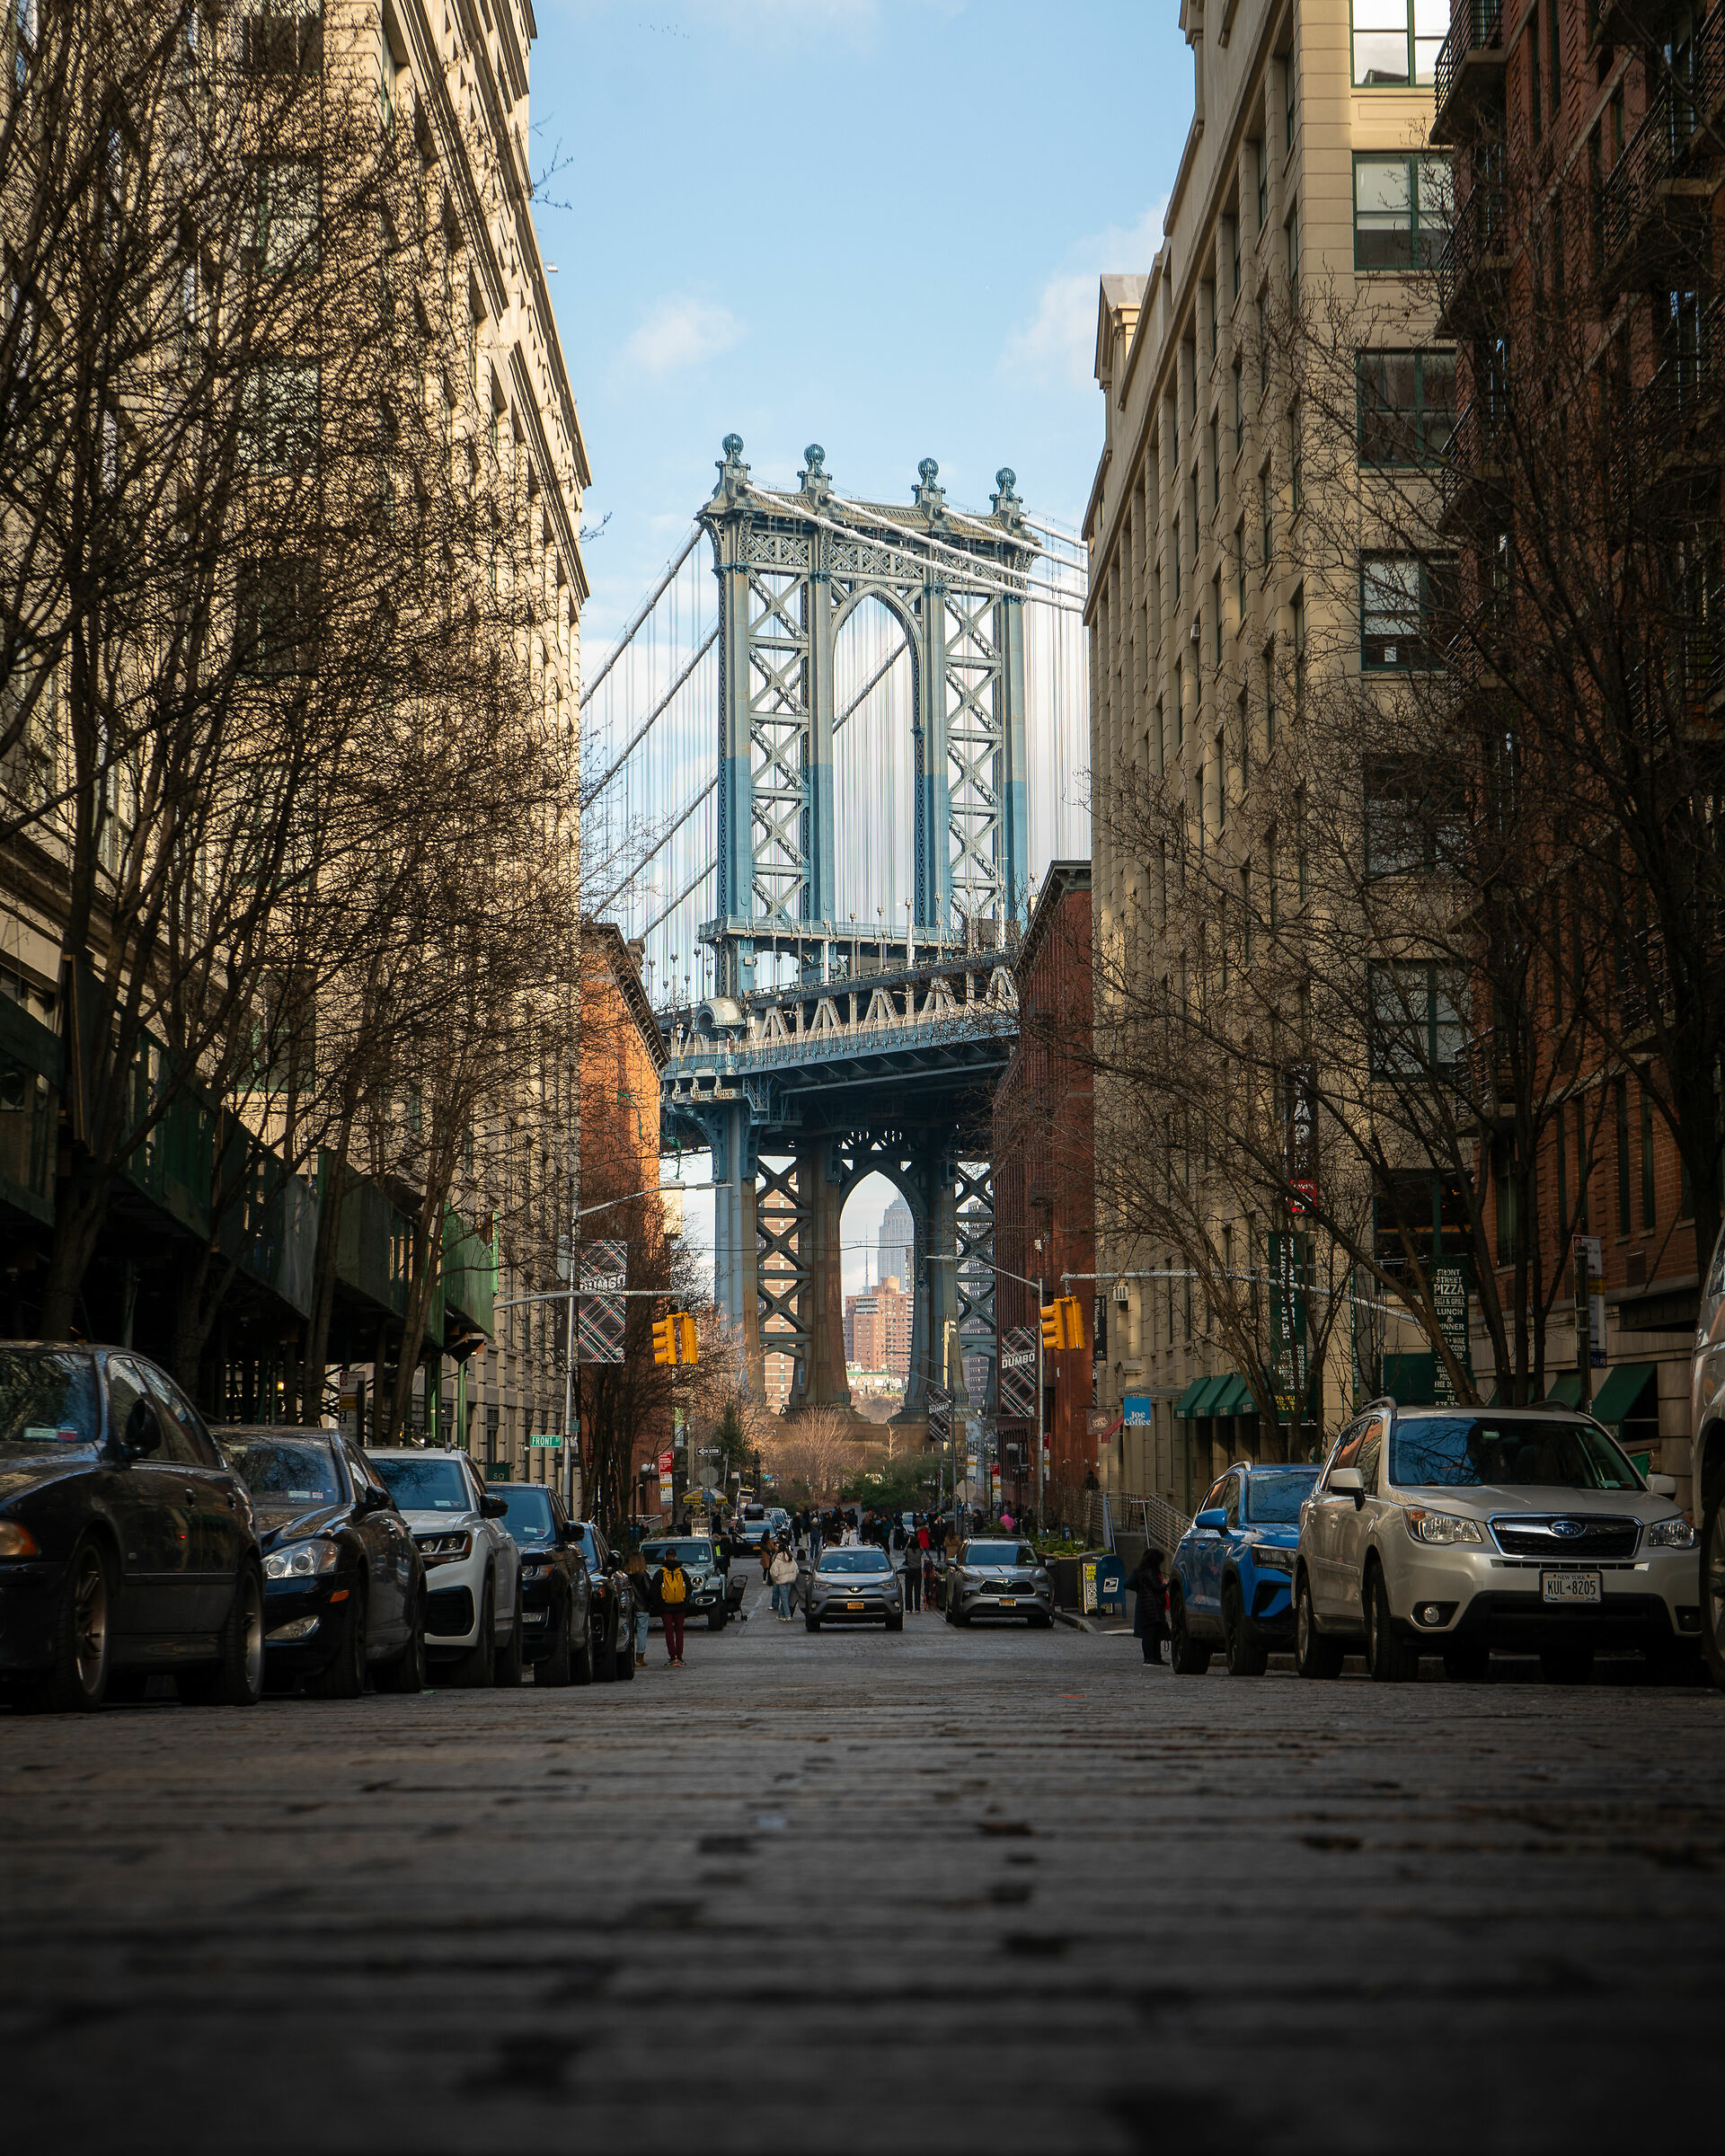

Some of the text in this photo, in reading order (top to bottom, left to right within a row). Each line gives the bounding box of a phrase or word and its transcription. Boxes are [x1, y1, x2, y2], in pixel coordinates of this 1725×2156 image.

[1433, 1284, 1464, 1294] PIZZA
[1002, 1352, 1035, 1369] DUMBO
[929, 1404, 949, 1414] DUMBO
[1129, 1411, 1146, 1420] Joe
[1124, 1417, 1151, 1426] Coffee
[532, 1437, 553, 1445] FRONT
[493, 1473, 505, 1481] sg
